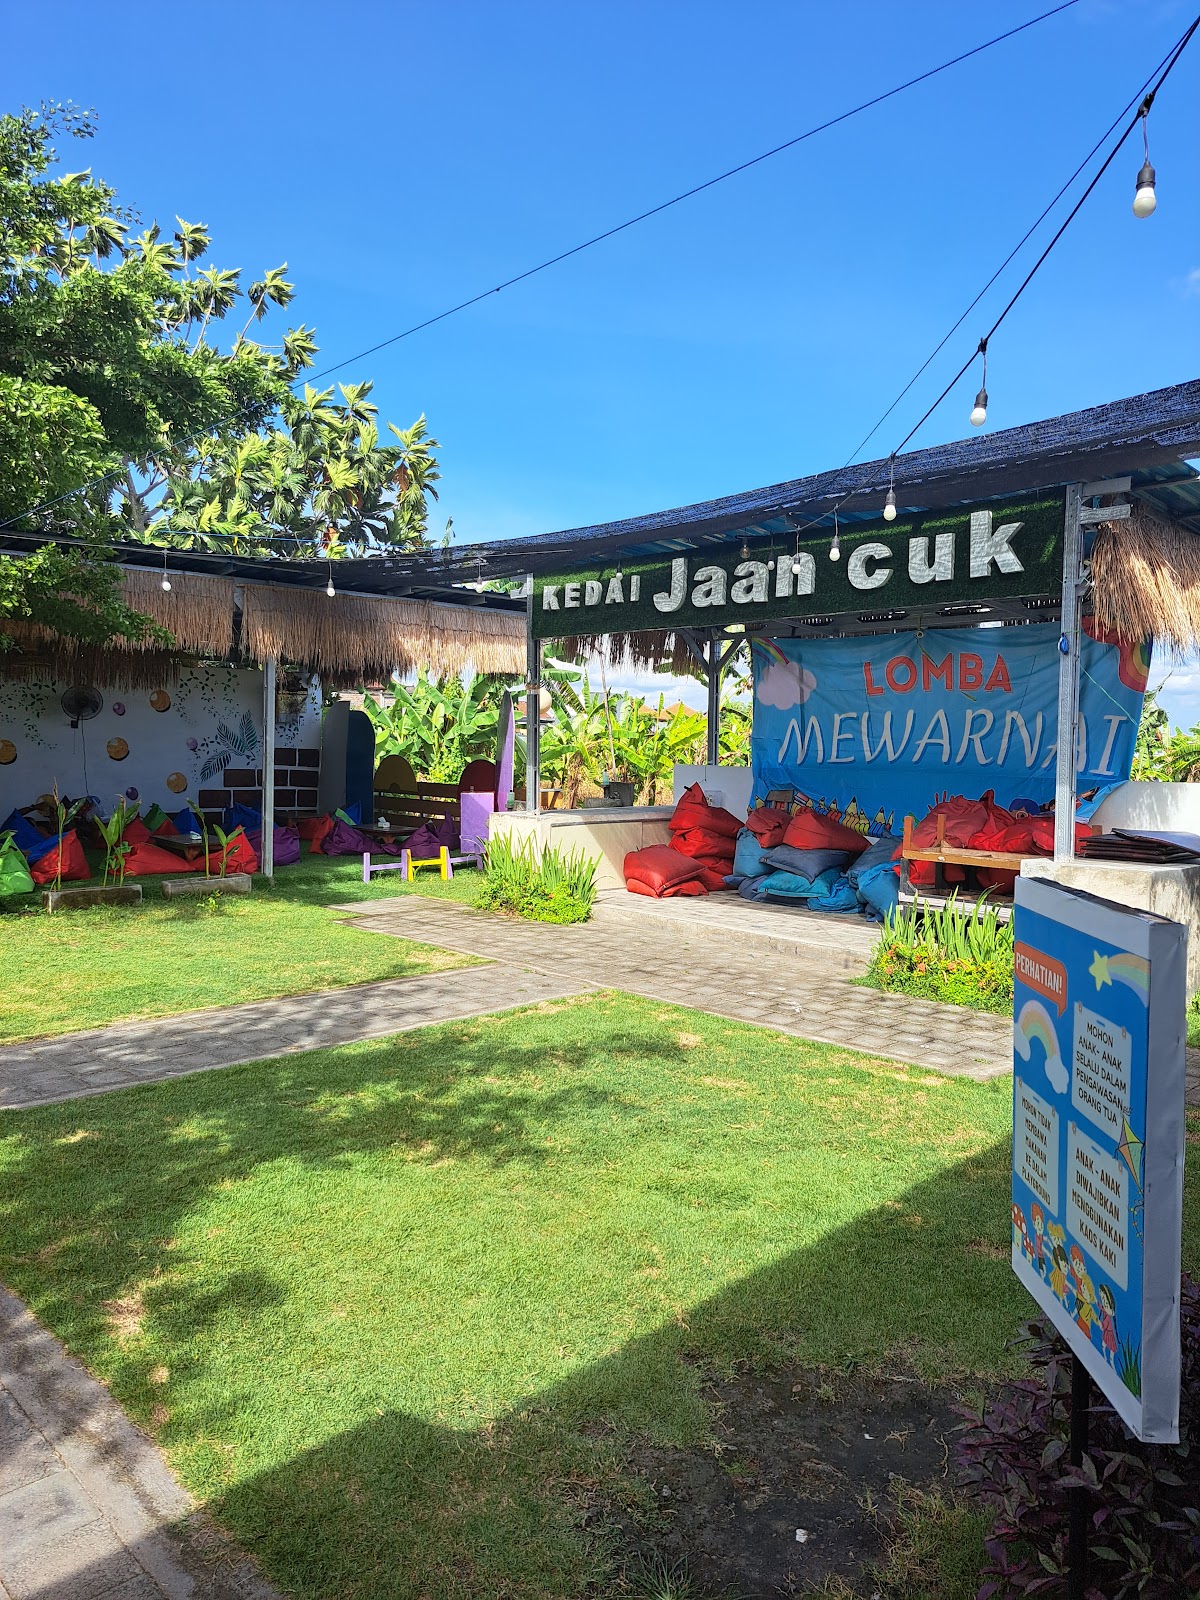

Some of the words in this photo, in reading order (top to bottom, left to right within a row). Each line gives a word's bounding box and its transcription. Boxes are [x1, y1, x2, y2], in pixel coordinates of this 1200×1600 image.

[543, 575, 641, 611] KEDAI
[653, 552, 816, 613] Jaan
[847, 510, 1025, 590] cuk
[863, 652, 1013, 696] LOMBA
[778, 708, 1127, 776] MEWARNAI
[1015, 951, 1063, 995] PERHATIAN!
[1087, 1022, 1113, 1047] MOHON
[1076, 1052, 1100, 1076] SELALU
[1102, 1070, 1127, 1094] DALAM
[1102, 1052, 1122, 1072] ANAK
[1077, 1068, 1123, 1111] PENGAWASAN
[1079, 1087, 1101, 1113] ORANG
[1103, 1107, 1117, 1126] TUA
[1022, 1096, 1037, 1120] MOHON
[1038, 1113, 1051, 1132] TIDAK
[1025, 1118, 1047, 1148] MEMBAWA
[1025, 1134, 1047, 1165] MAKANAN
[1026, 1153, 1032, 1165] KE
[1032, 1159, 1047, 1184] DALAM
[1022, 1166, 1051, 1206] PLAYGROUND
[1076, 1147, 1093, 1173] ANAK
[1100, 1169, 1121, 1198] ANAK
[1076, 1170, 1119, 1222] DIWAJIBKAN
[1072, 1189, 1124, 1251] MENGGUNAKAN
[1080, 1218, 1097, 1246] KAOS
[1099, 1241, 1117, 1268] KAKI
